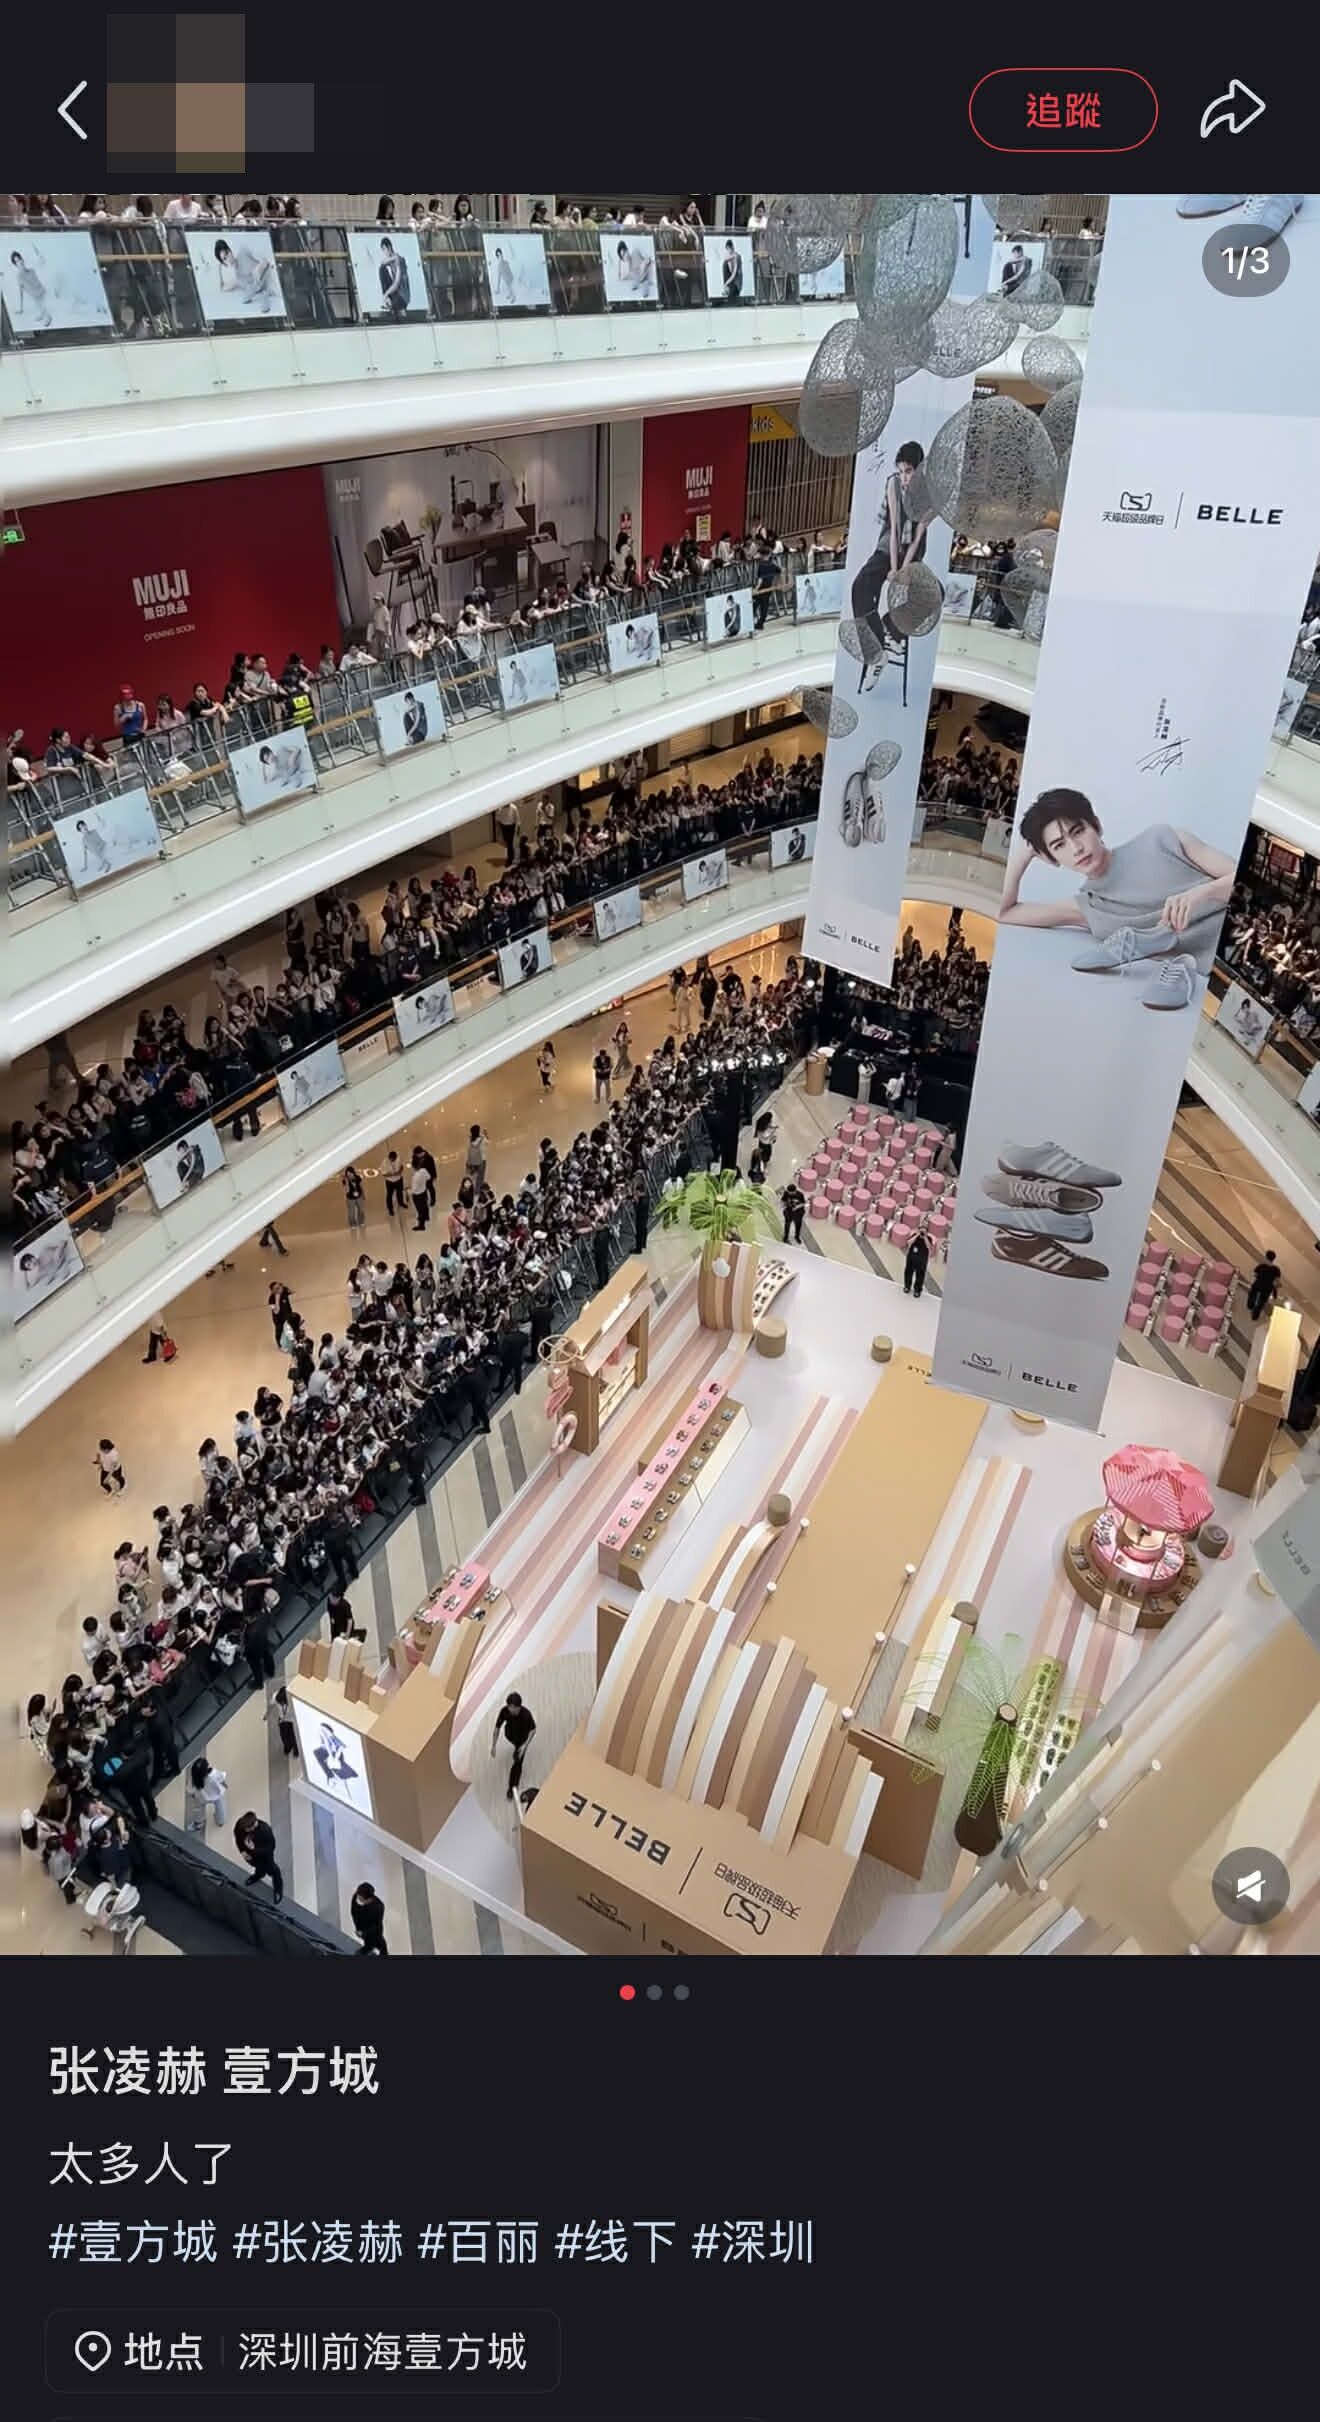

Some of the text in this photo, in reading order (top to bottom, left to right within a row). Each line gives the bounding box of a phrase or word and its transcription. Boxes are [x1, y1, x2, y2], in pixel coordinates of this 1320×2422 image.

[685, 464, 713, 489] MUJI
[1197, 504, 1284, 525] BELLE
[132, 569, 191, 606] MUJI
[850, 935, 881, 953] BELLE
[1021, 1371, 1081, 1394] BELLE
[563, 1791, 672, 1866] BELLE
[713, 1862, 801, 1921] 天猫超级品牌日
